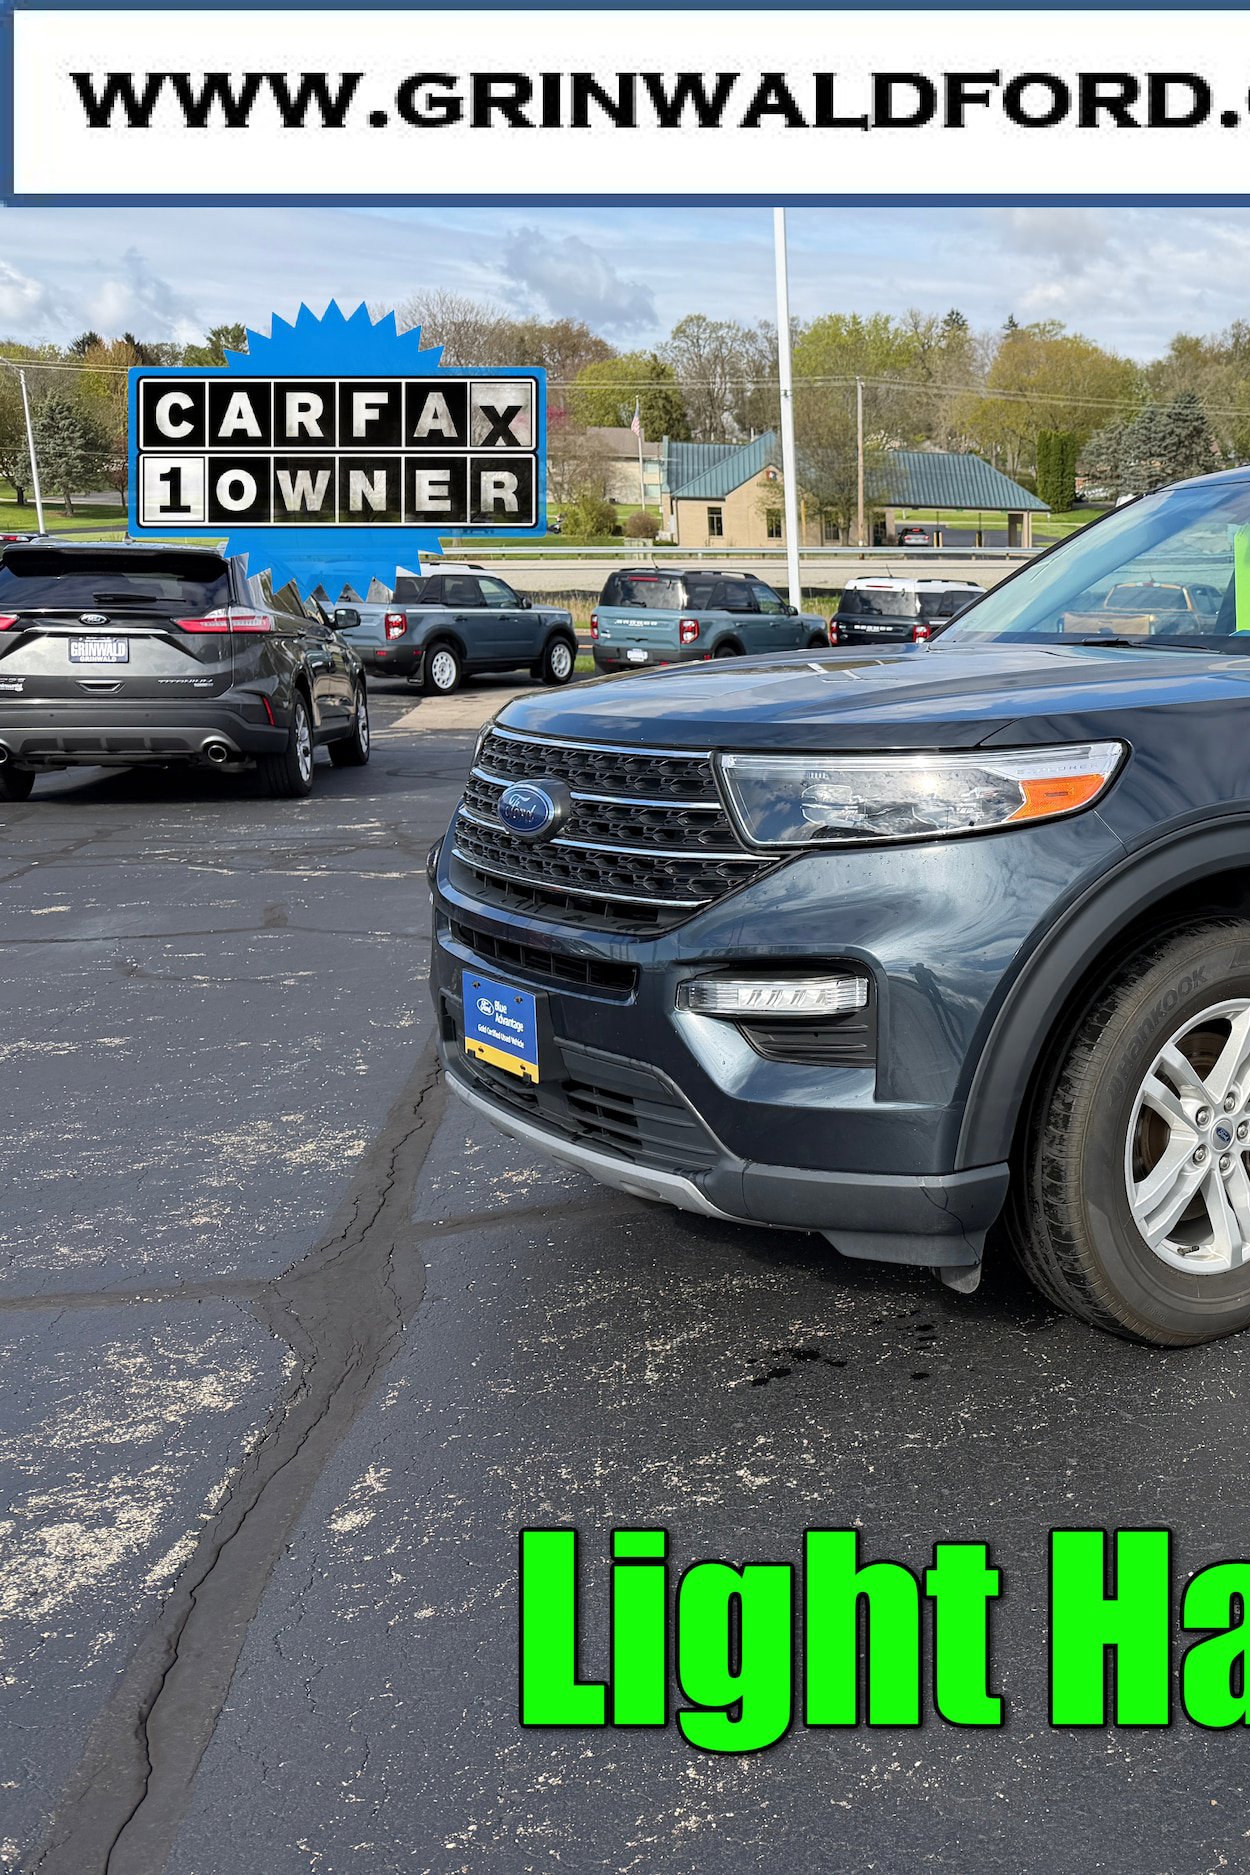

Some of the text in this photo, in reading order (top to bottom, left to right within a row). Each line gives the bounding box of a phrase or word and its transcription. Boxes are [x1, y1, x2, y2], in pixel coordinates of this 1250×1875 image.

[70, 641, 126, 657] GRINWALD
[504, 793, 537, 822] Ford
[493, 1000, 508, 1014] Blue
[495, 1012, 524, 1033] Advantage
